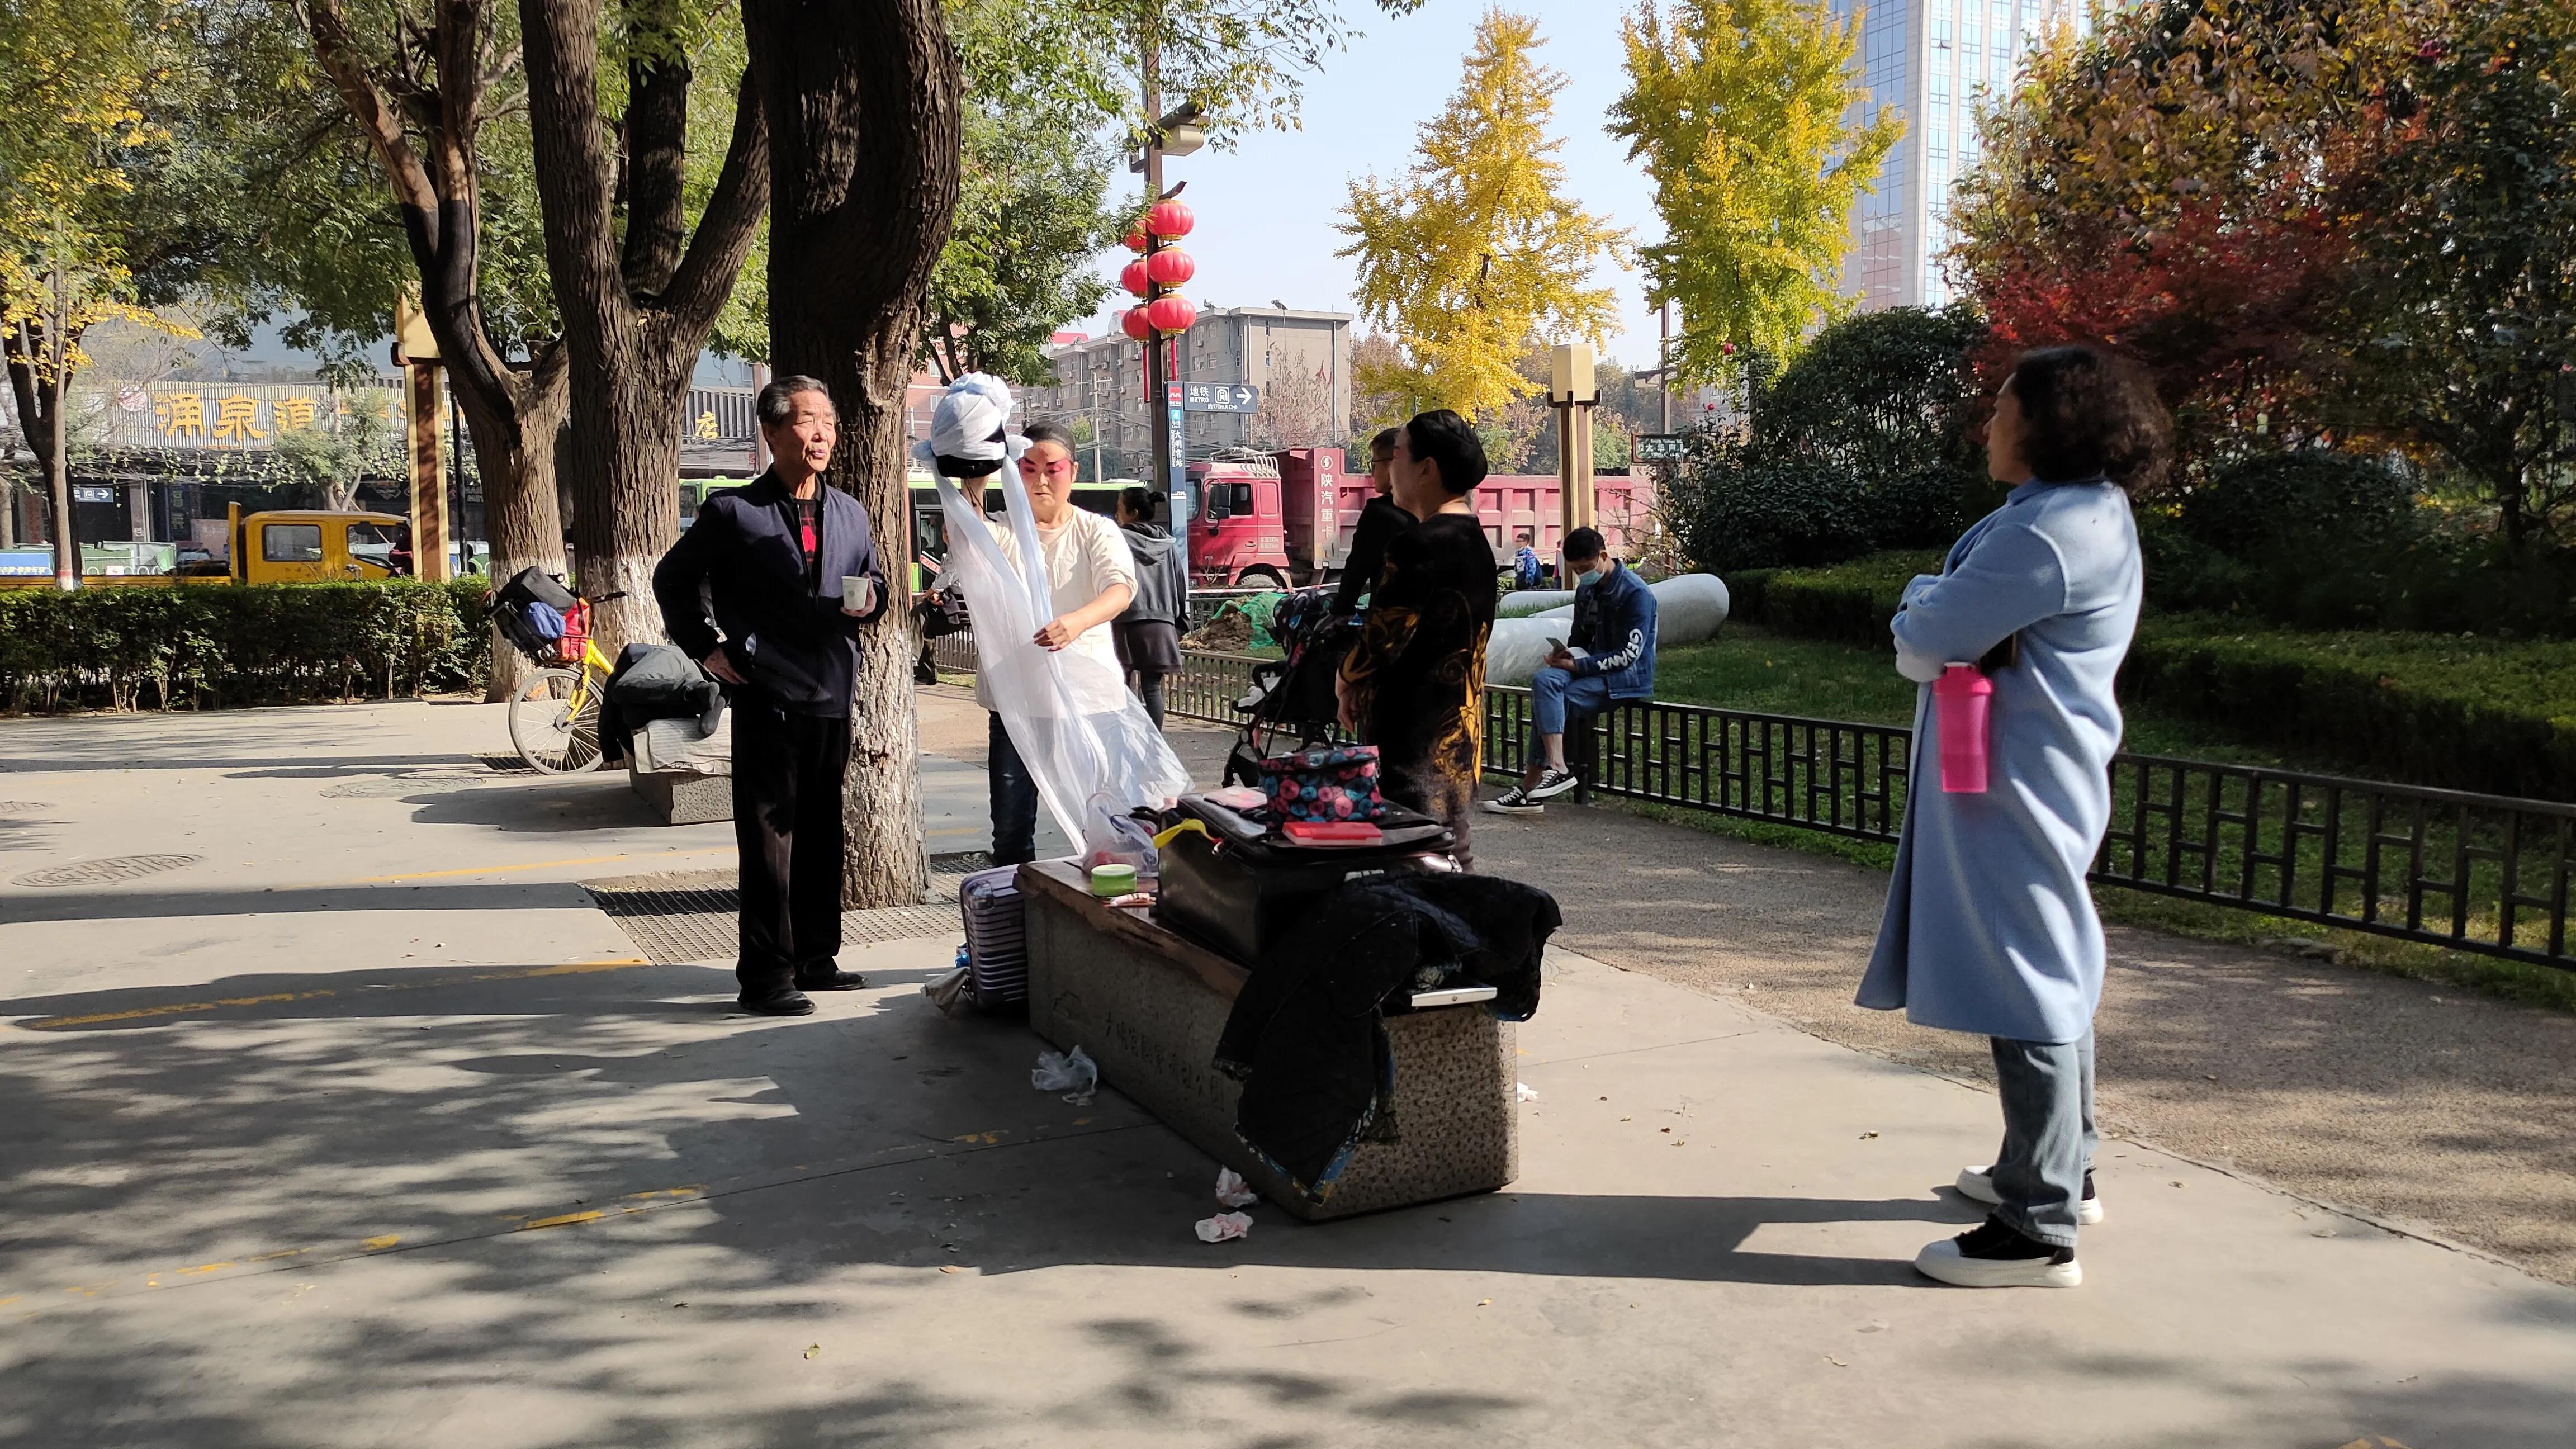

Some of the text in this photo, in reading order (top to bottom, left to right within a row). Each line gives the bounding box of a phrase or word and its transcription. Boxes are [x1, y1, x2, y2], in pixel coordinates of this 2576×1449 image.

[1190, 386, 1209, 396] 地铁
[1320, 473, 1334, 539] 陕汽重卡
